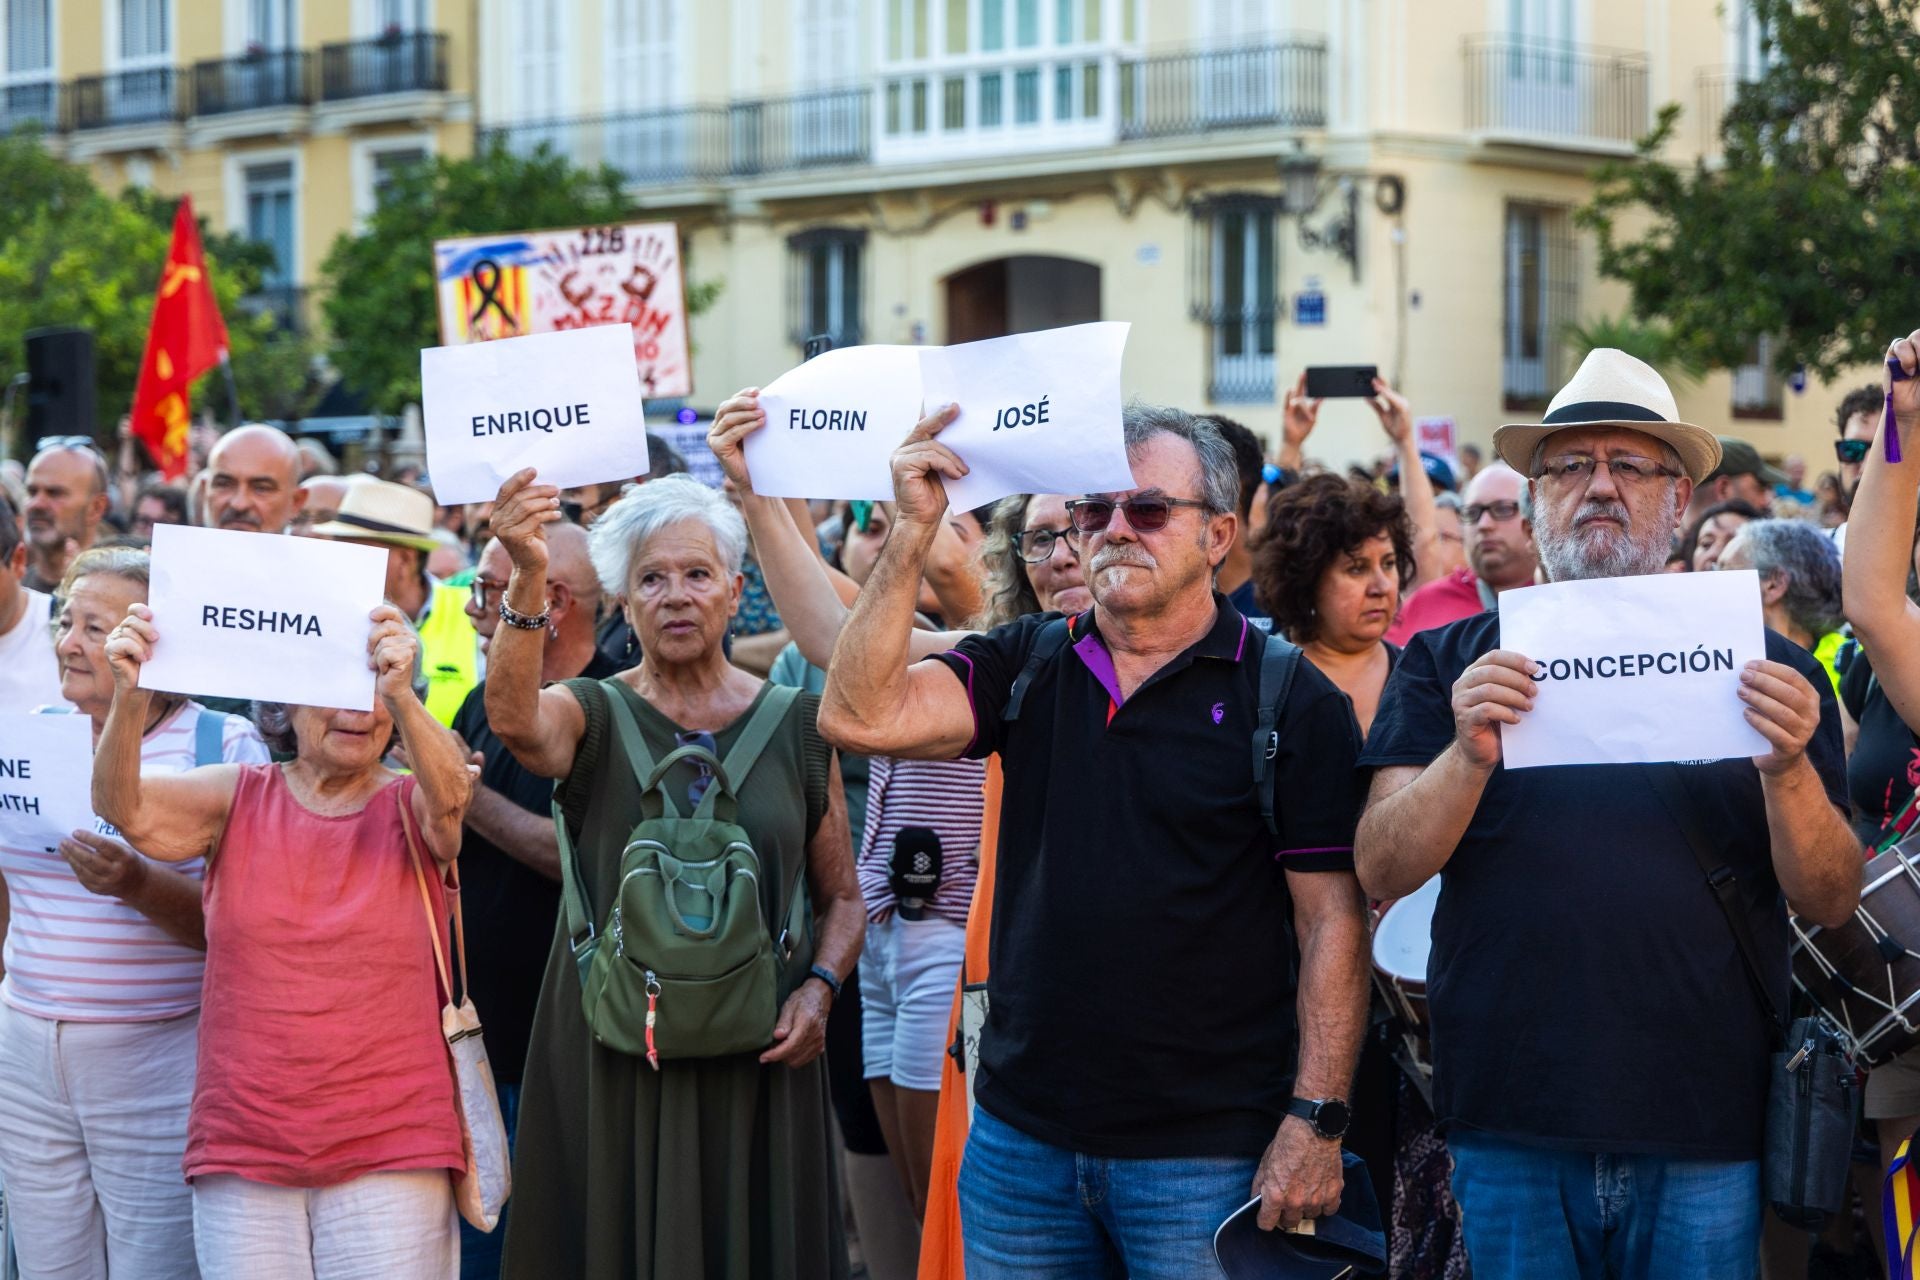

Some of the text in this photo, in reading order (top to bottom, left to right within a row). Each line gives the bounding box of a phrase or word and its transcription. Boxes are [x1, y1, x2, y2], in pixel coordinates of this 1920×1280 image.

[472, 403, 590, 437] ENRIQUE
[789, 409, 867, 431] FLORIN
[992, 394, 1050, 432] JOSÉ
[202, 605, 322, 637] RESHMA
[1529, 644, 1734, 682] CONCEPCIÓN
[0, 793, 40, 816] ITH
